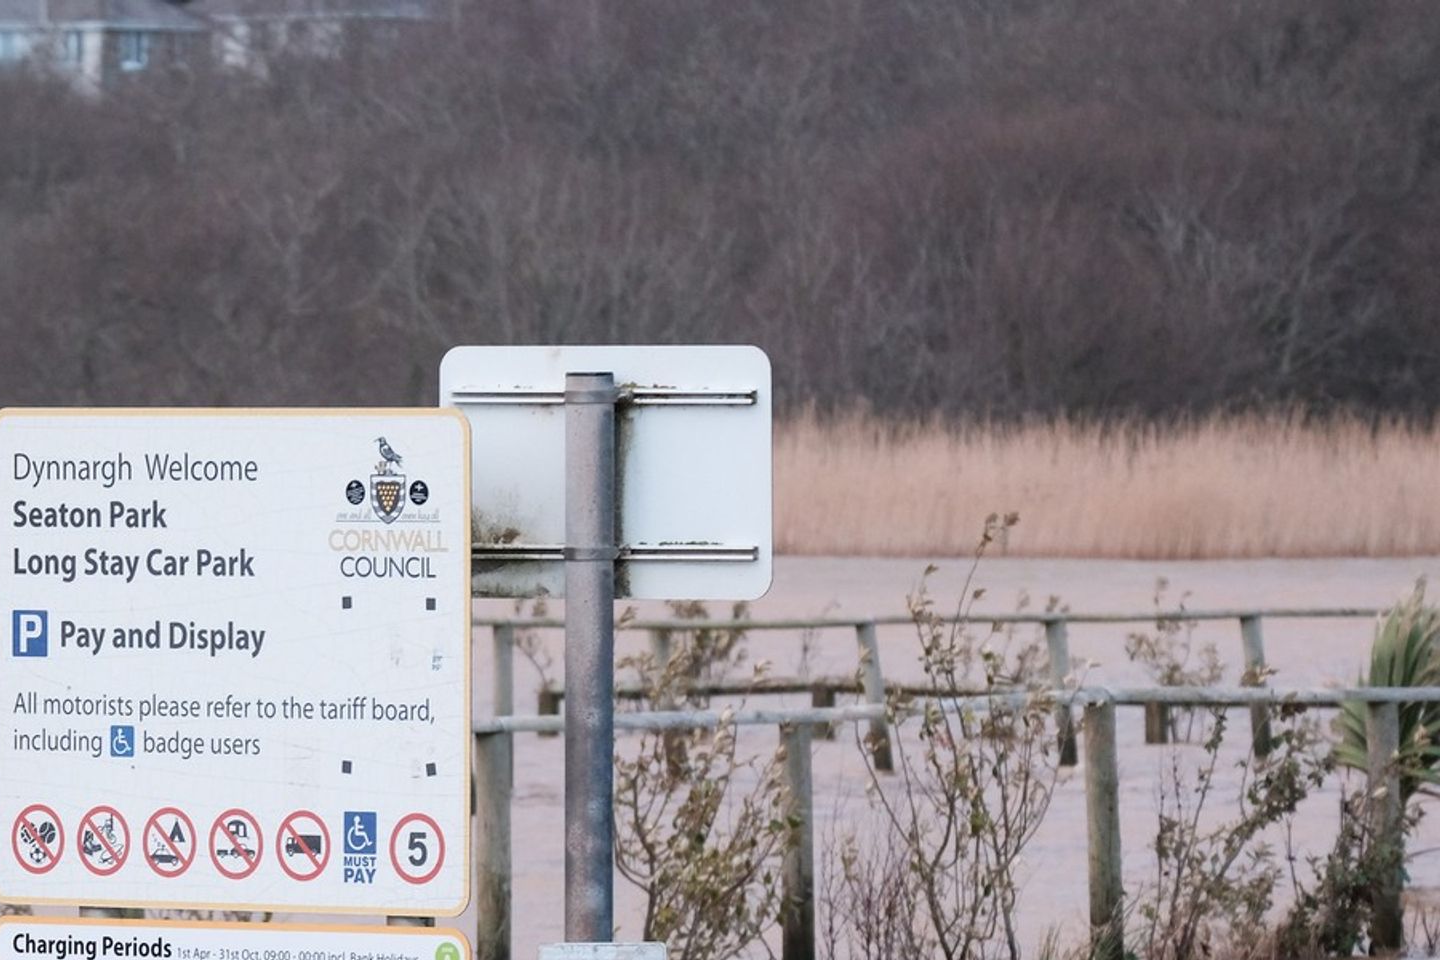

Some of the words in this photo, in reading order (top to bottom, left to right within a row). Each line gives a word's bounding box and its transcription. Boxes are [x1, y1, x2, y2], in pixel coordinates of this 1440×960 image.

[13, 452, 132, 487] Dynnargh
[145, 454, 258, 482] Welcome
[13, 500, 101, 529] Seaton
[109, 501, 167, 529] Park
[329, 529, 449, 552] CORNWALL
[13, 548, 77, 583] Long
[84, 549, 140, 583] Stay
[147, 549, 189, 578] Car
[196, 549, 255, 578] Park
[340, 556, 437, 579] COUNCIL
[19, 614, 43, 653] P
[60, 620, 106, 654] Pay
[113, 620, 161, 650] and
[169, 622, 266, 658] Display
[13, 692, 38, 715] All
[43, 694, 134, 717] motorists
[139, 695, 201, 723] please
[206, 695, 251, 719] refer
[256, 699, 277, 720] to
[282, 696, 314, 720] the
[318, 696, 368, 721] tariff
[371, 698, 436, 725] board,
[13, 728, 103, 758] including
[143, 731, 205, 759] badge
[210, 736, 261, 756] users
[343, 856, 377, 868] MUST
[407, 832, 427, 867] 5
[343, 868, 377, 884] PAY
[13, 933, 97, 960] Charging
[102, 936, 172, 958] Periods
[177, 948, 191, 959] 1st
[219, 948, 240, 960] 31st
